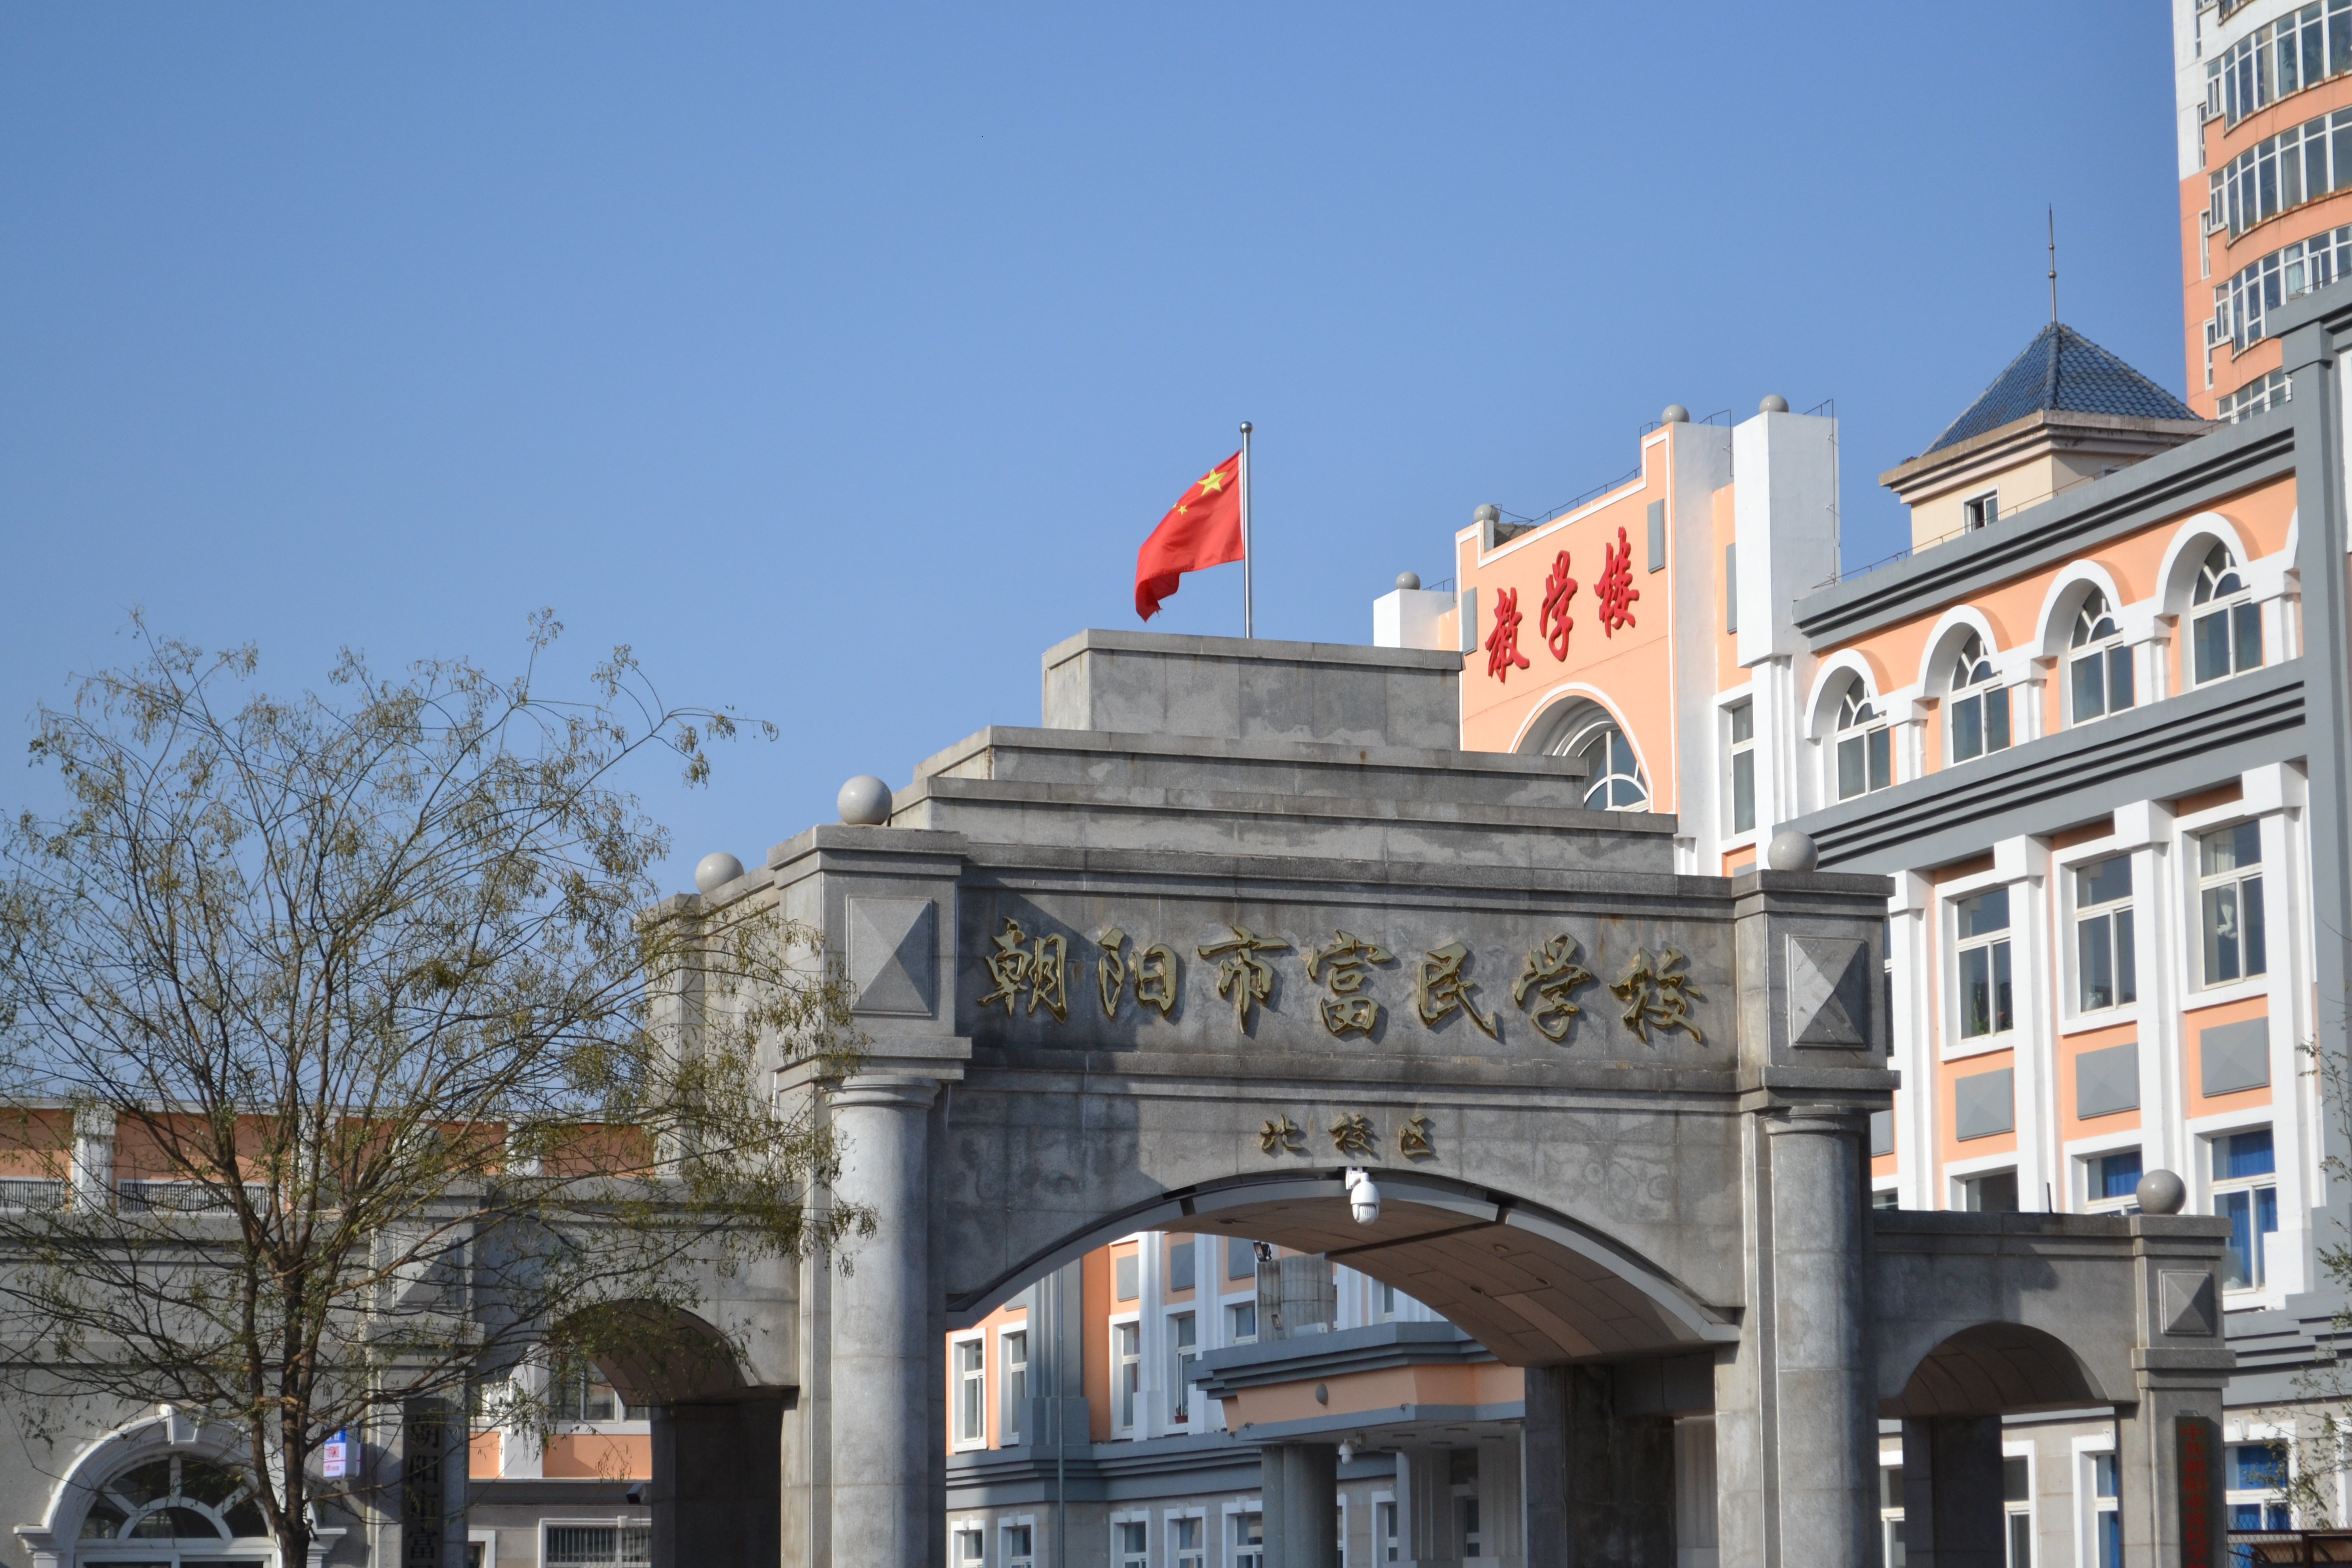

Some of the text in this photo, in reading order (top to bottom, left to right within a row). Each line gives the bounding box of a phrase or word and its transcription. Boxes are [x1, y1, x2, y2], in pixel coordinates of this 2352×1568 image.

[1485, 526, 1639, 683] 教学楼
[977, 917, 1703, 1044] 朝阳市富民学校
[1260, 1112, 1432, 1159] 北校区
[408, 1414, 438, 1568] 朝阳市富
